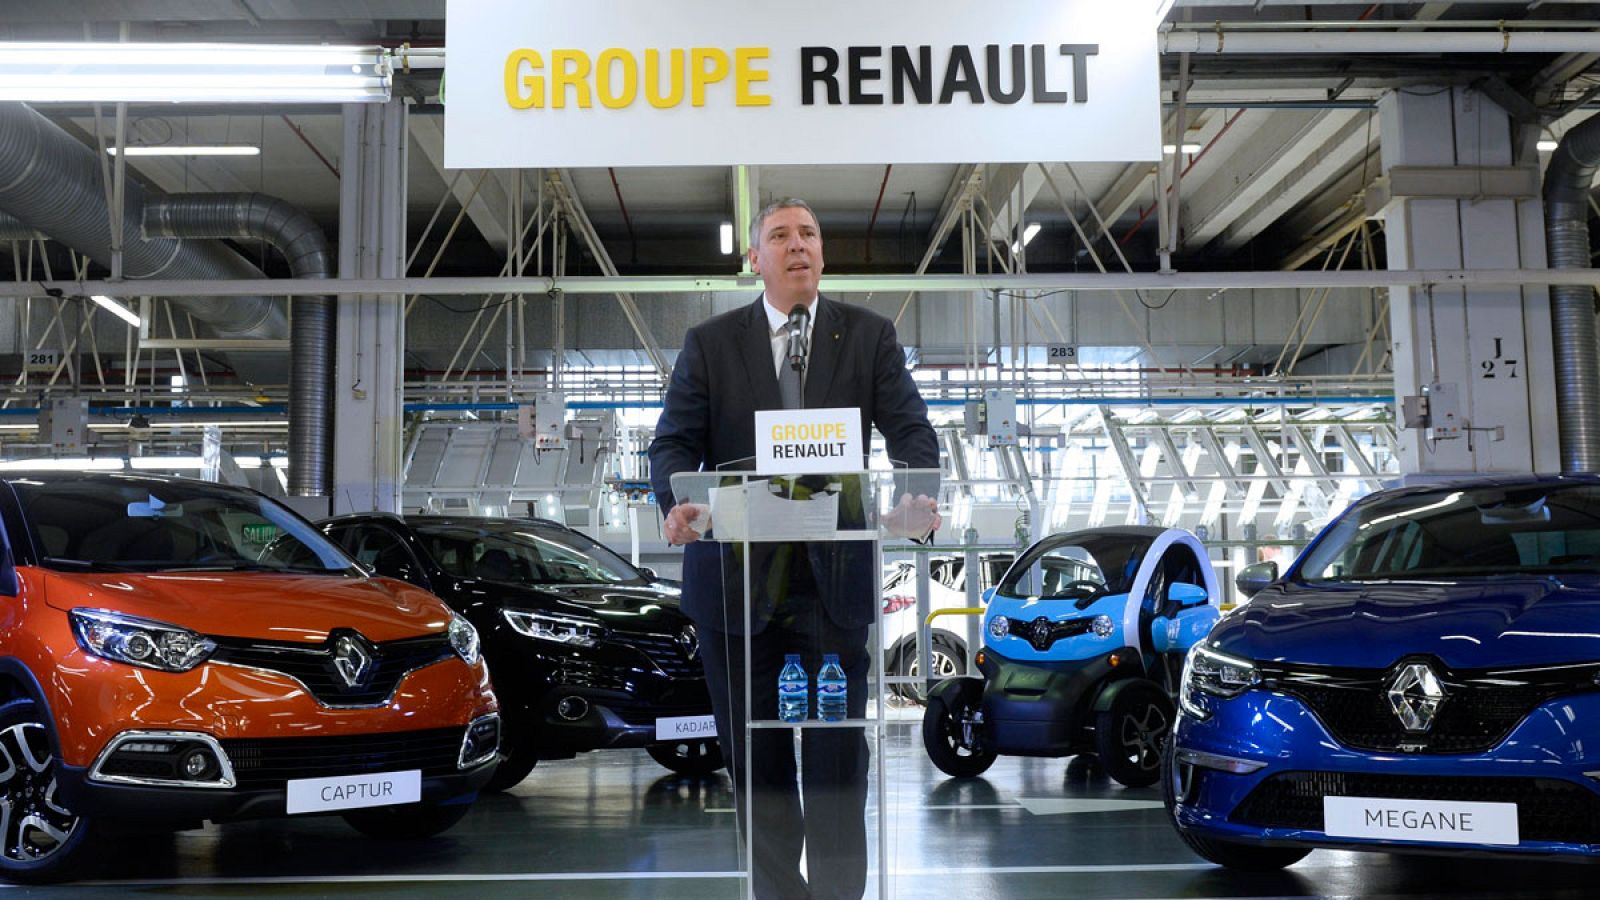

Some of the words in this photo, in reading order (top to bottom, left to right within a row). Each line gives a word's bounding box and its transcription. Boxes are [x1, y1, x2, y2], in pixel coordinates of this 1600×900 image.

[504, 46, 771, 110] GROUPE
[801, 43, 1099, 106] RENAULT
[31, 354, 53, 364] 281
[1051, 347, 1075, 357] 283
[771, 422, 848, 441] GROUPE
[772, 442, 846, 459] RENAULT
[320, 781, 393, 802] CAPTUR
[1365, 809, 1473, 832] MEGANE
